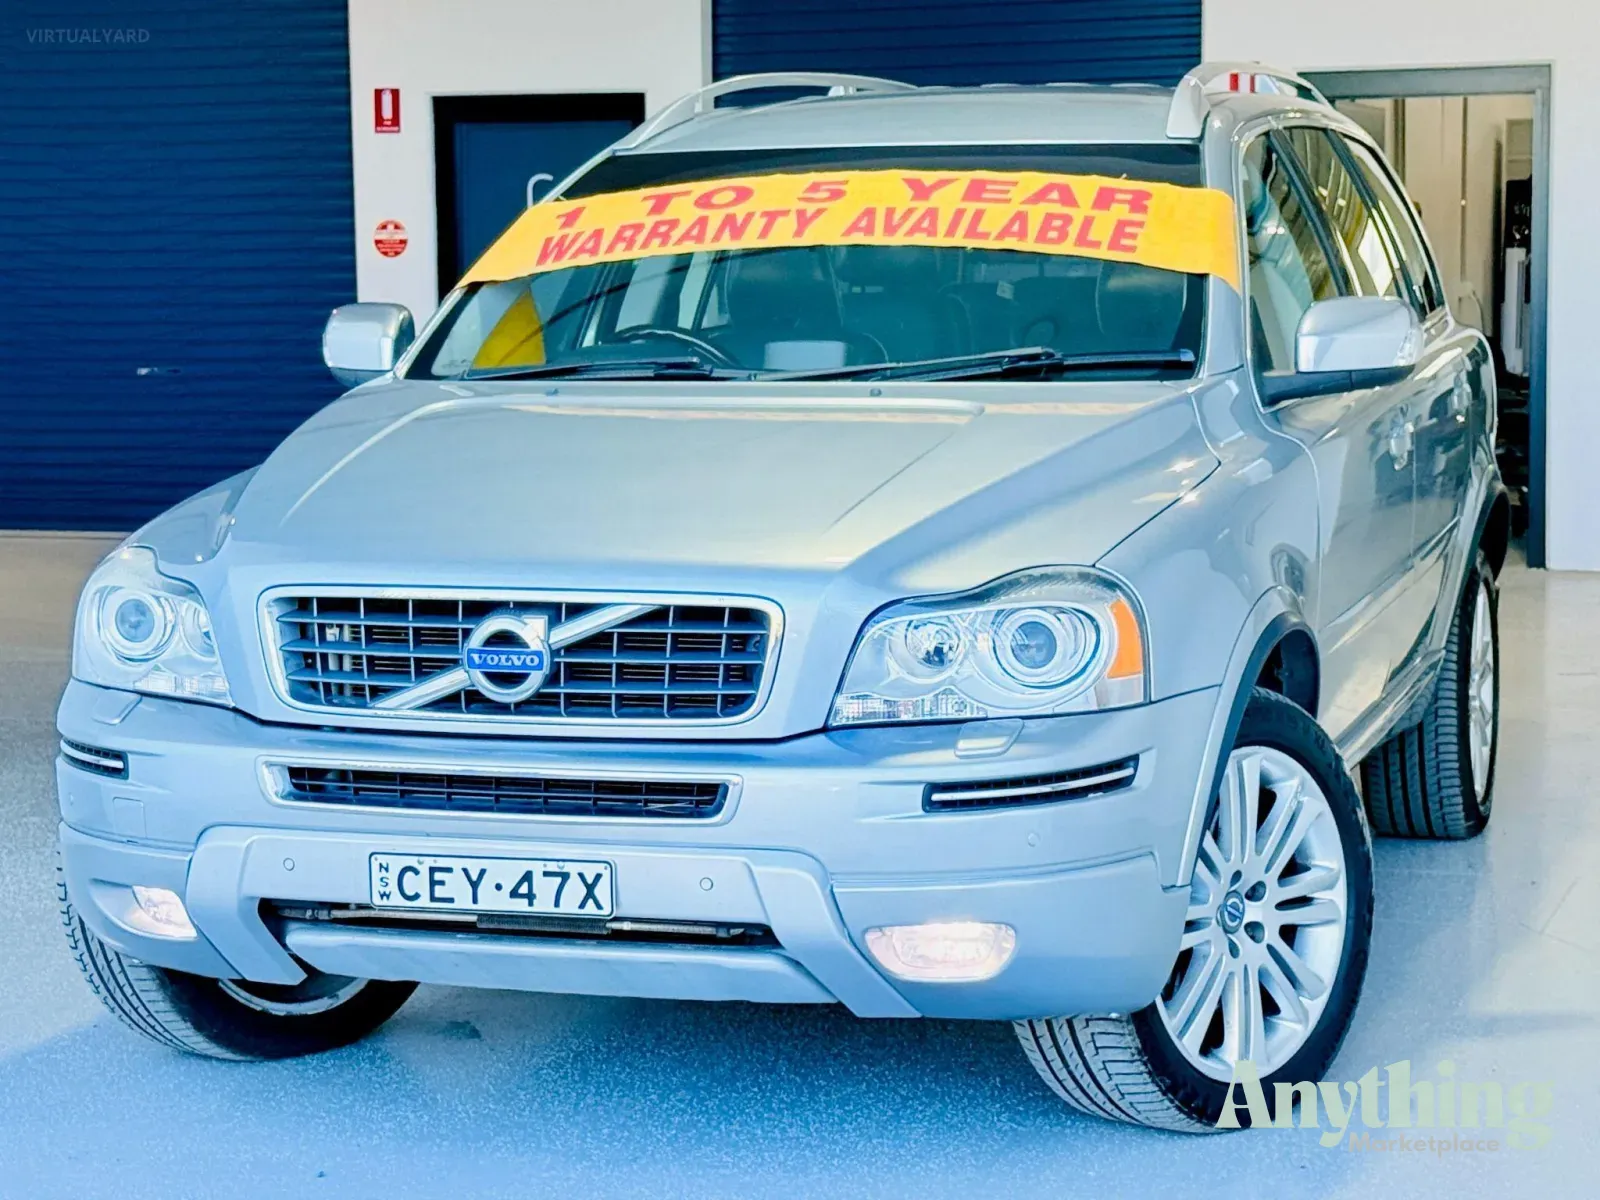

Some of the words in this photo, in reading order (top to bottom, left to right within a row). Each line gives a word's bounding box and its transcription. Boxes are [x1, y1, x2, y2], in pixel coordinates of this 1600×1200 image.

[556, 206, 586, 230] 1
[641, 185, 755, 216] TO
[797, 180, 850, 203] 5
[902, 178, 1153, 214] YEAR
[535, 207, 828, 267] WARRANTY
[841, 207, 1146, 253] AVAILABLE
[470, 653, 539, 667] VOLVO
